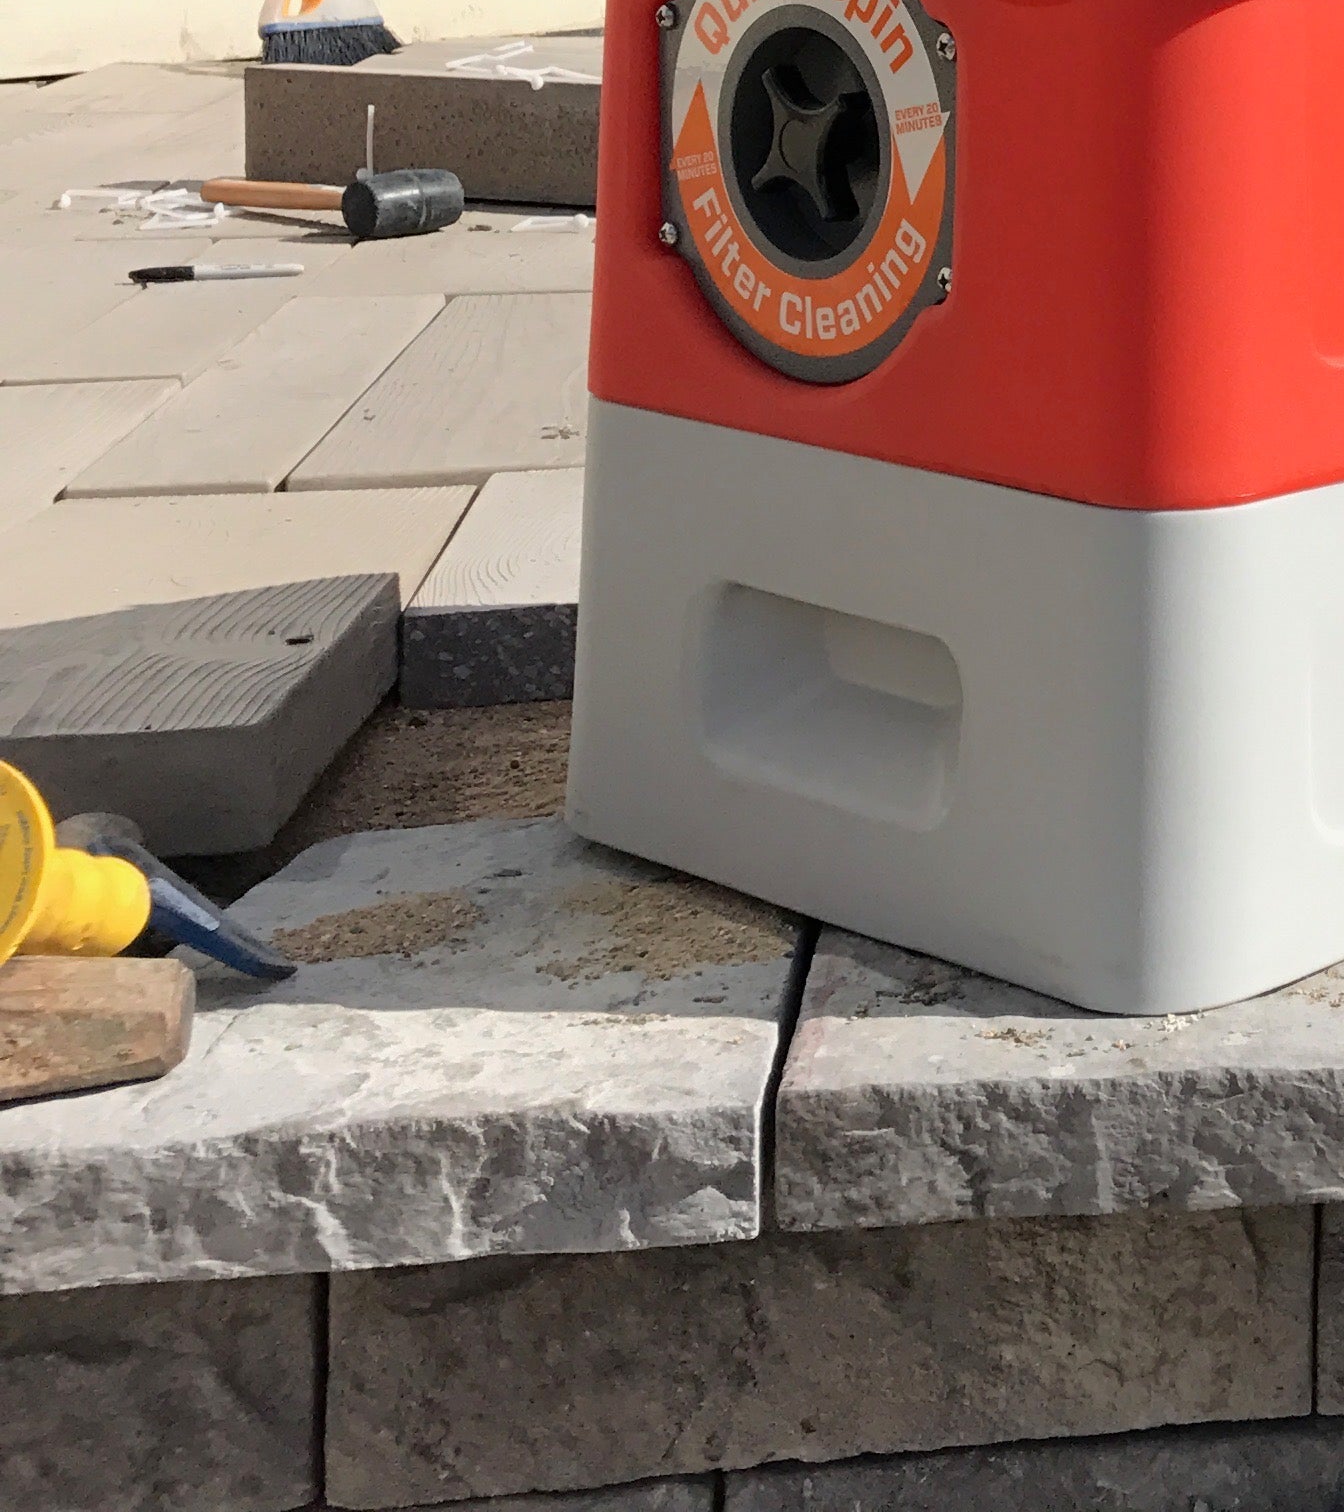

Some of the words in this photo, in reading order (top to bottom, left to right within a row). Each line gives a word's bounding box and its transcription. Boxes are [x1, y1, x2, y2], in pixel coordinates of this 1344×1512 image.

[894, 104, 924, 121] EVERY
[926, 102, 939, 115] 20
[895, 114, 943, 136] MINUTES
[676, 162, 718, 182] MINUTES
[692, 187, 772, 312] Filter
[778, 218, 927, 340] Cleaning
